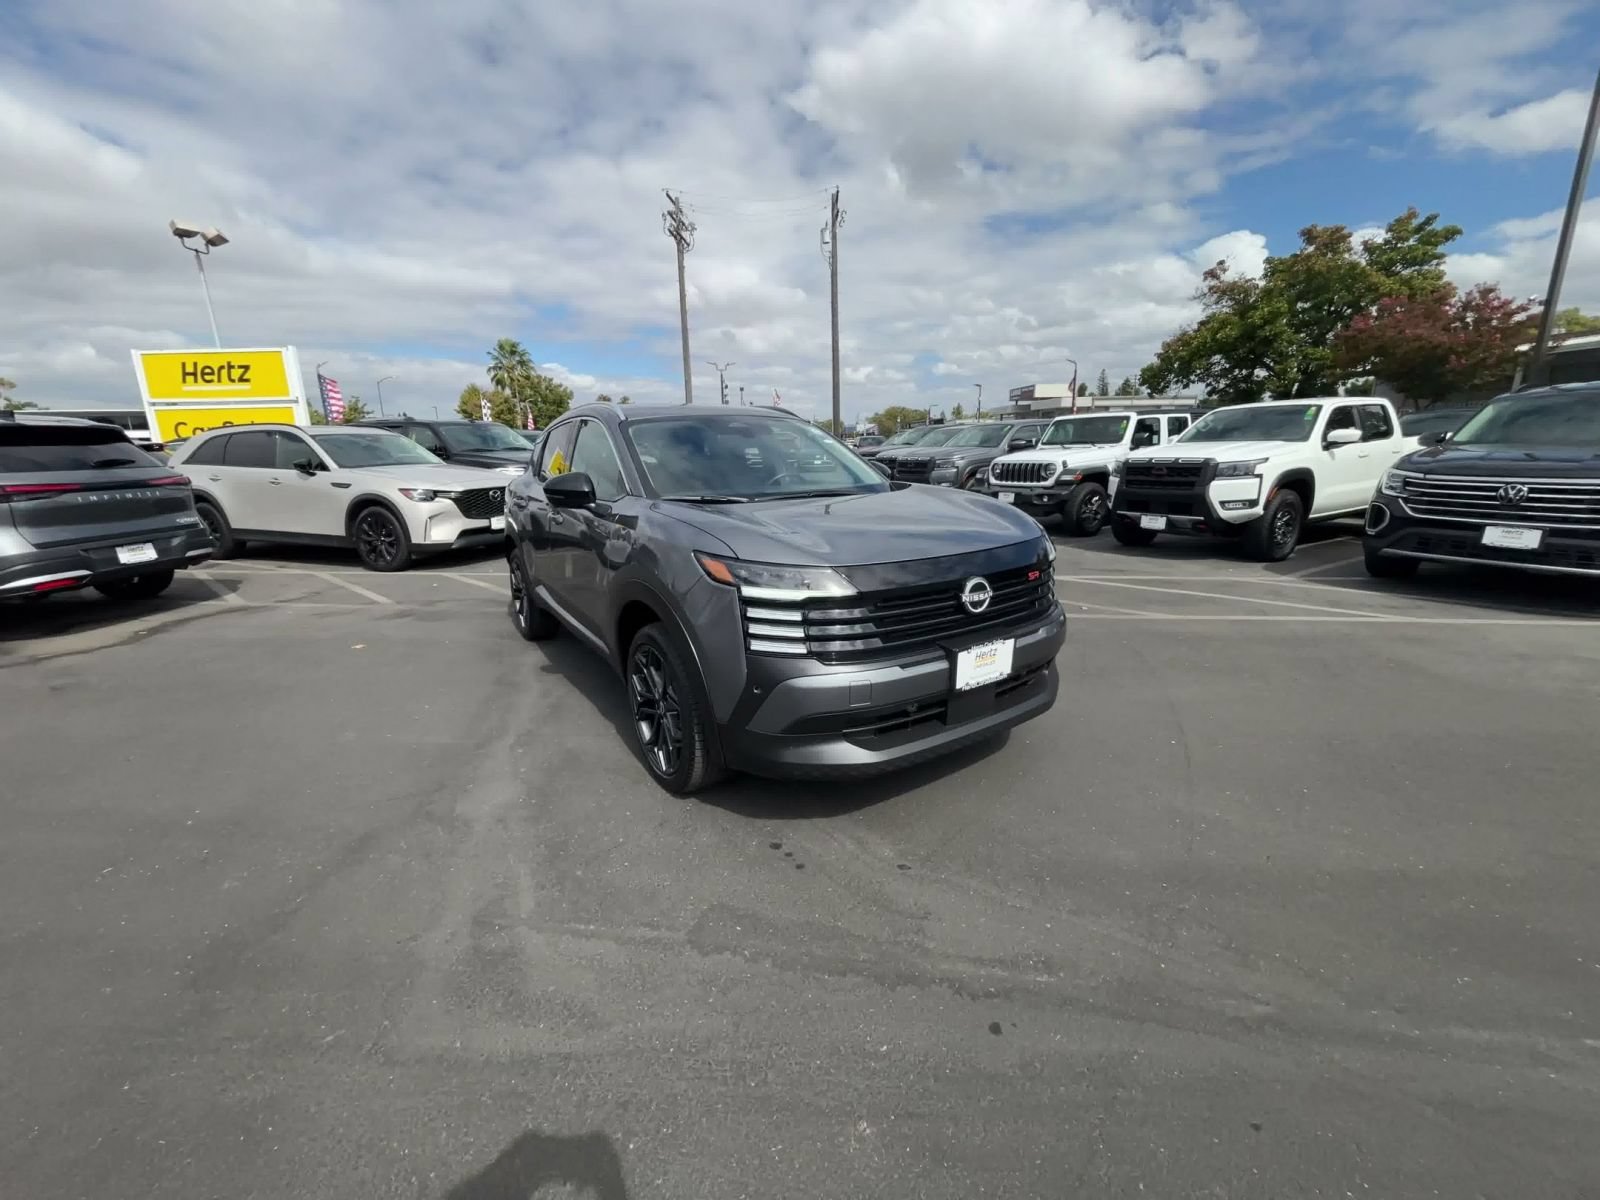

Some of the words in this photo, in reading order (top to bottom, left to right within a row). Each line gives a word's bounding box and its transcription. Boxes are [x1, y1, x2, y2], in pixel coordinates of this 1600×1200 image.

[181, 361, 251, 384] Hertz
[77, 491, 160, 502] INFINITI
[962, 590, 993, 602] NISSAN
[975, 648, 998, 661] Hertz
